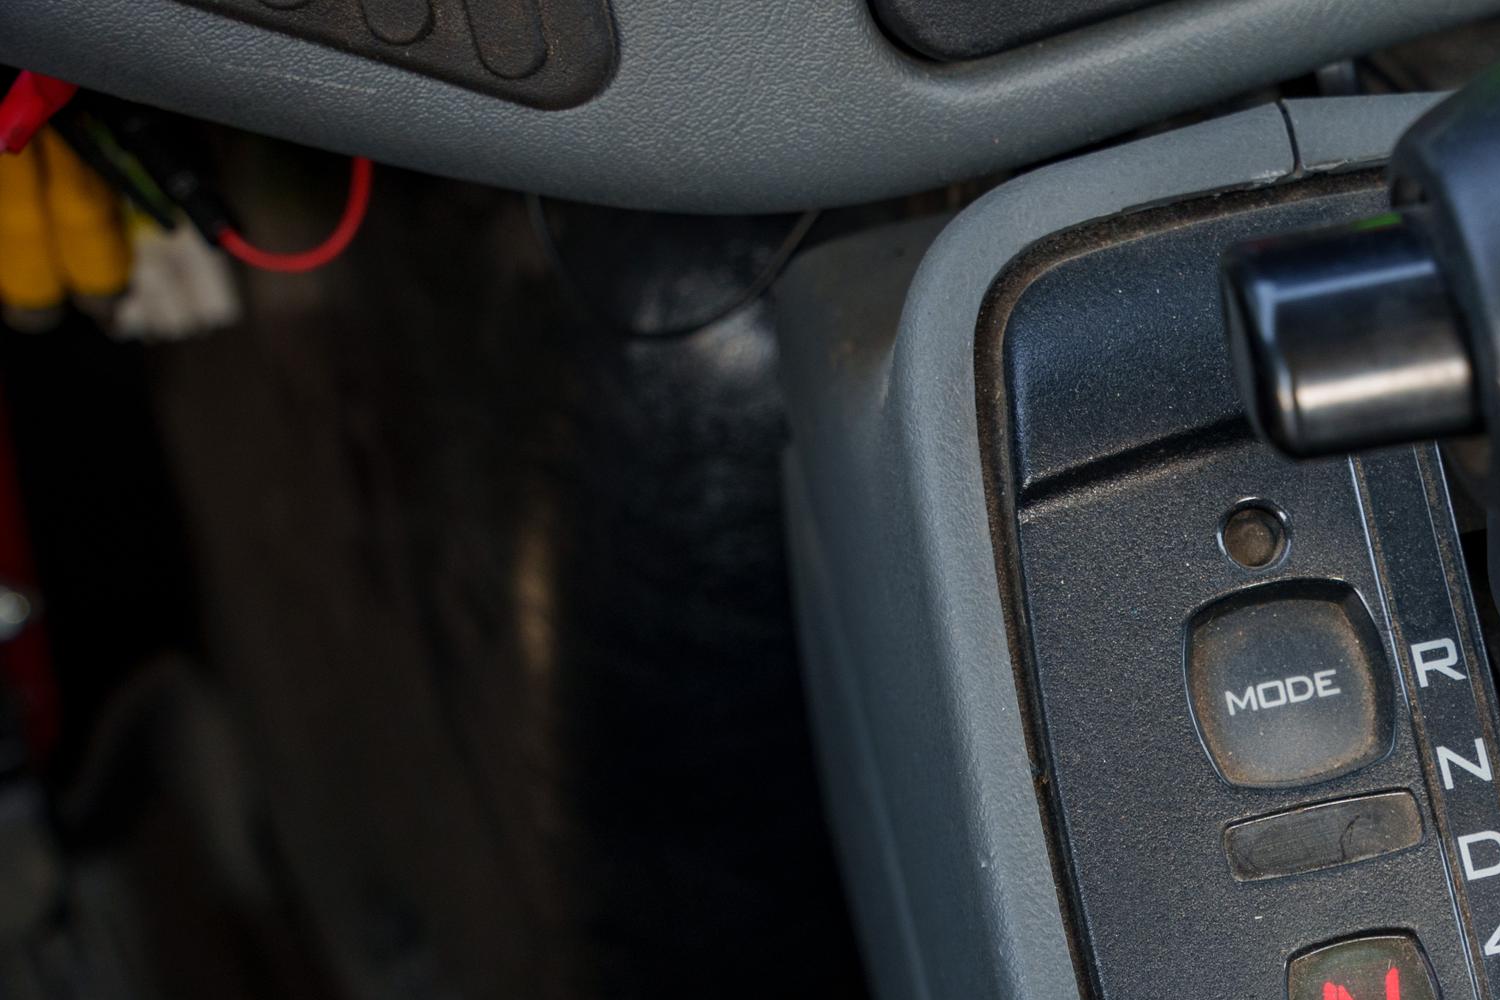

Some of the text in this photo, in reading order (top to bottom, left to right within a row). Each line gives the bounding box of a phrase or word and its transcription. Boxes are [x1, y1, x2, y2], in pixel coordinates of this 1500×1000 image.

[1411, 638, 1466, 687] R
[1224, 669, 1341, 716] MODE
[1436, 738, 1492, 789] N
